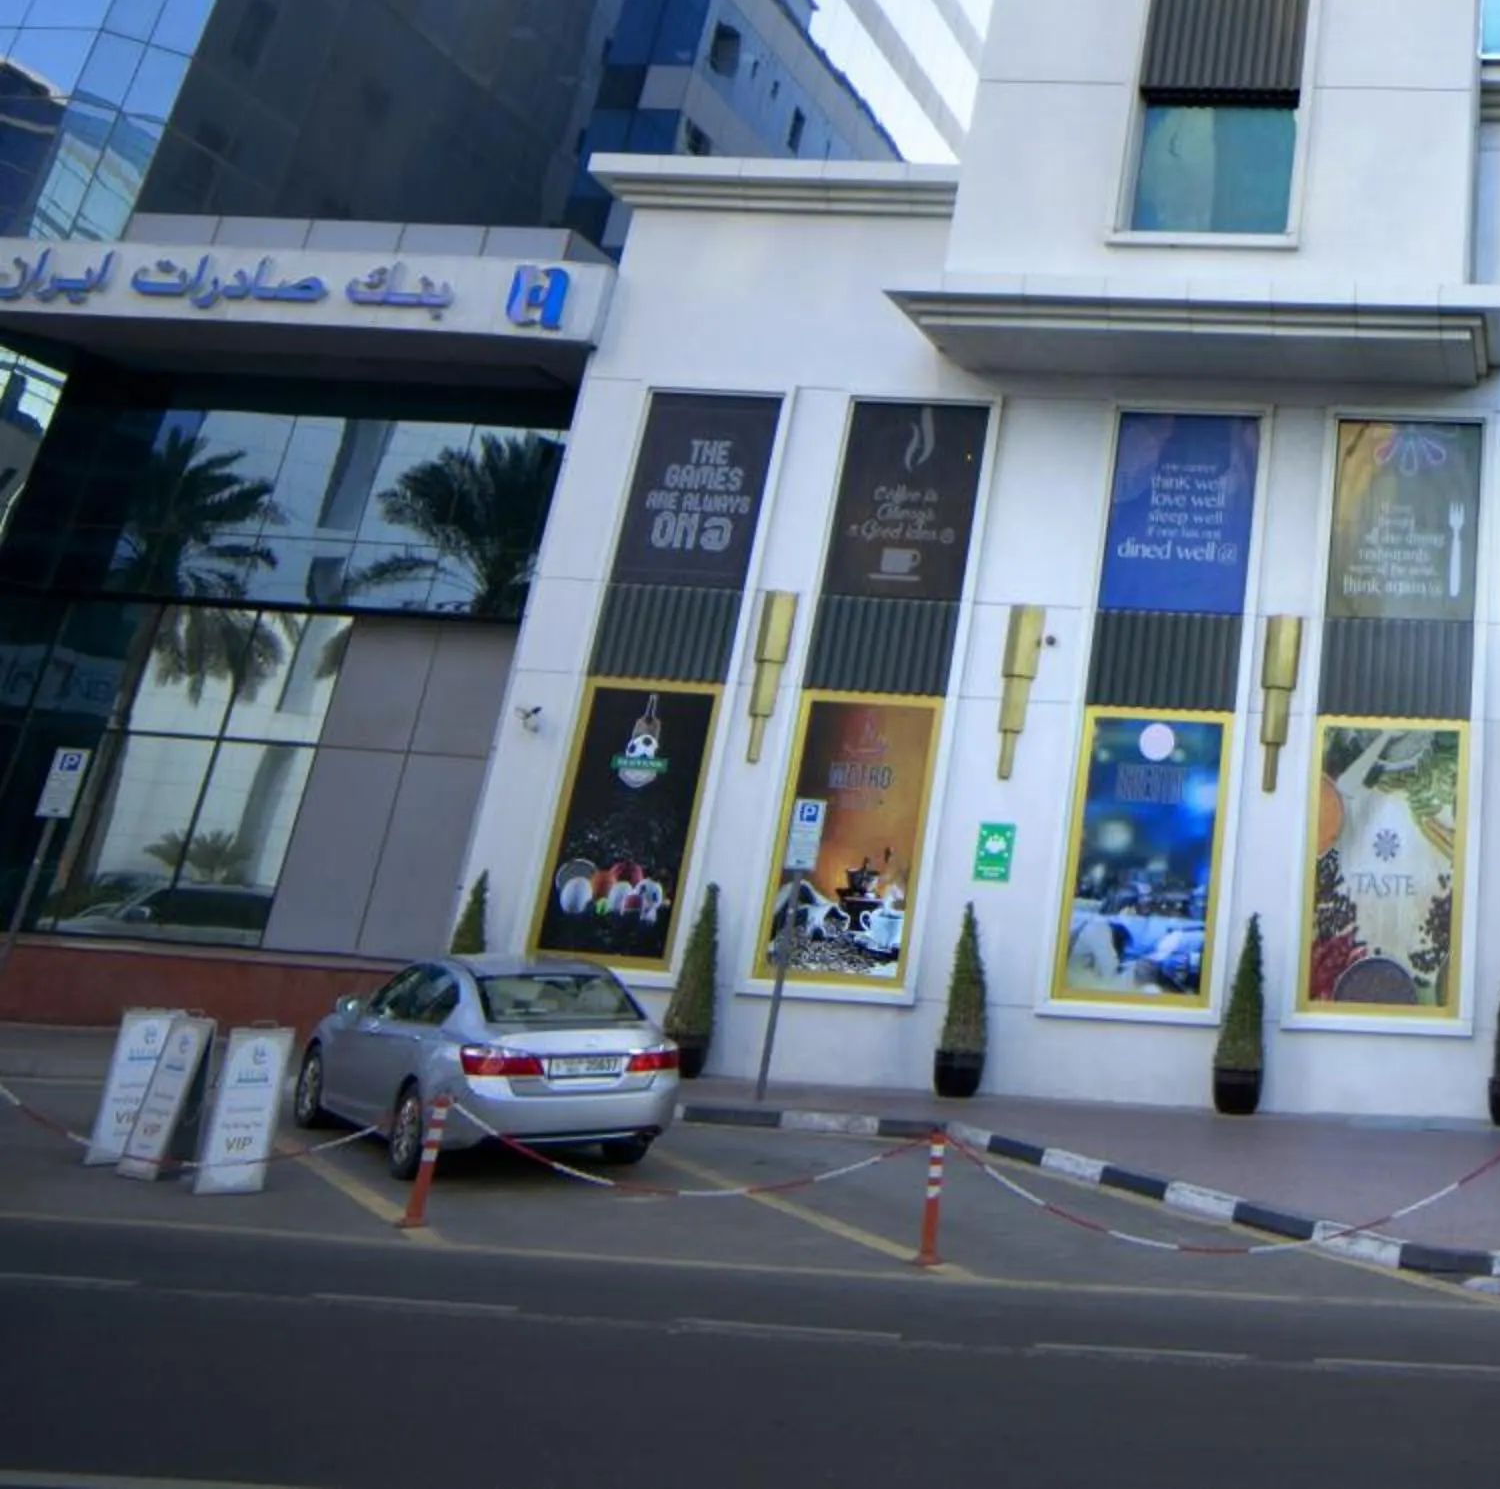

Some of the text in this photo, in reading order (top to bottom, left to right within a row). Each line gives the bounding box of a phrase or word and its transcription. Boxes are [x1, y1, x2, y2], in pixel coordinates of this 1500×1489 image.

[130, 254, 329, 310] صادرات
[691, 439, 733, 465] THE
[664, 464, 744, 492] GAMES
[645, 490, 752, 515] ARE ALWAYS
[1151, 490, 1225, 508] love well
[1147, 509, 1223, 526] sleep well
[1117, 537, 1173, 560] dined
[1176, 540, 1216, 562] well
[1351, 872, 1417, 899] TASTE
[225, 1136, 253, 1152] VIP
